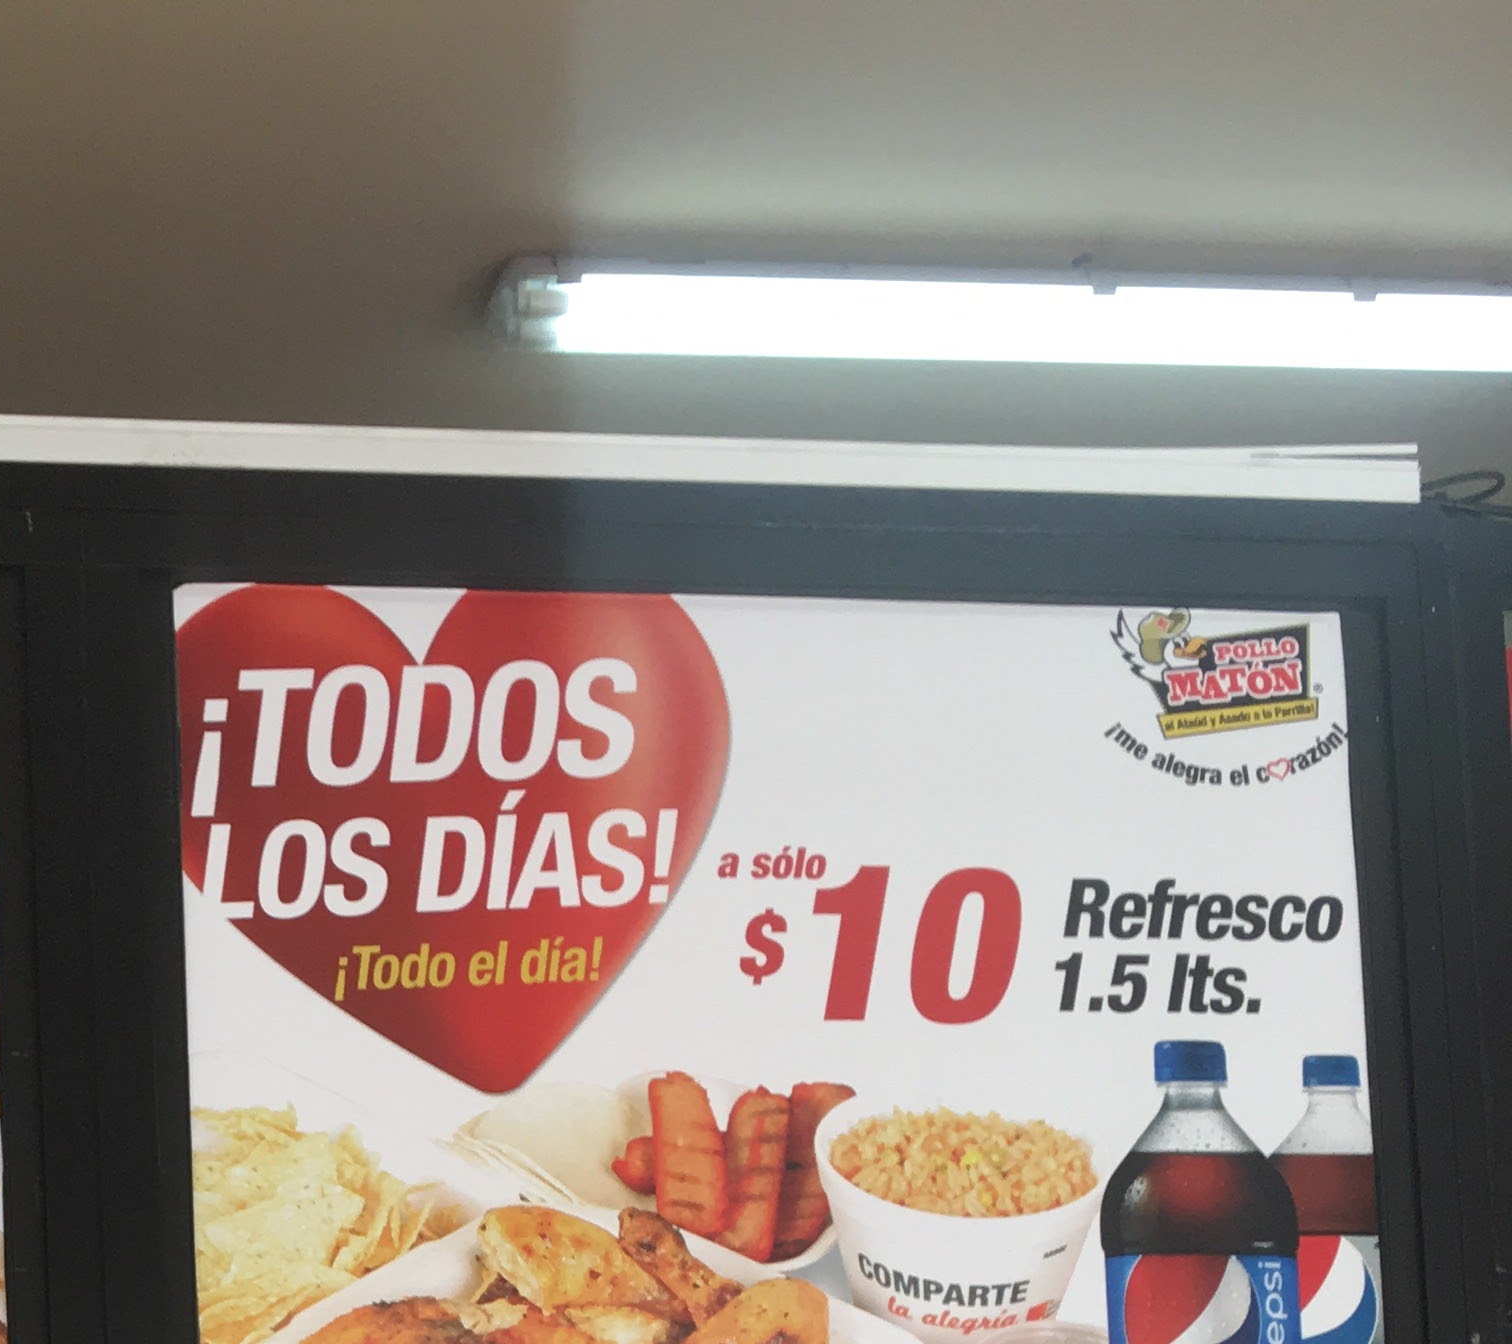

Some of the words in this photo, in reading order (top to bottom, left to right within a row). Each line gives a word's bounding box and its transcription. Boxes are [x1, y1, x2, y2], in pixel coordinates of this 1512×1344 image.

[1213, 637, 1299, 663] POLLO
[1164, 659, 1302, 705] MATÓN
[191, 658, 637, 818] ¡TODOS
[1151, 752, 1222, 785] alegra
[1230, 764, 1249, 785] el
[202, 818, 391, 920] LOS
[416, 790, 678, 913] DÍAS!
[717, 851, 739, 879] a
[751, 846, 827, 880] sólo
[1063, 877, 1343, 942] Refresco
[334, 943, 455, 1001] ¡Todo
[468, 940, 507, 986] el
[520, 937, 603, 985] día!
[1054, 953, 1150, 1014] 1.5
[1167, 952, 1262, 1014] lts.
[858, 1251, 1030, 1307] COMPARTE
[887, 1294, 912, 1319] la
[921, 1308, 1019, 1334] alegría
